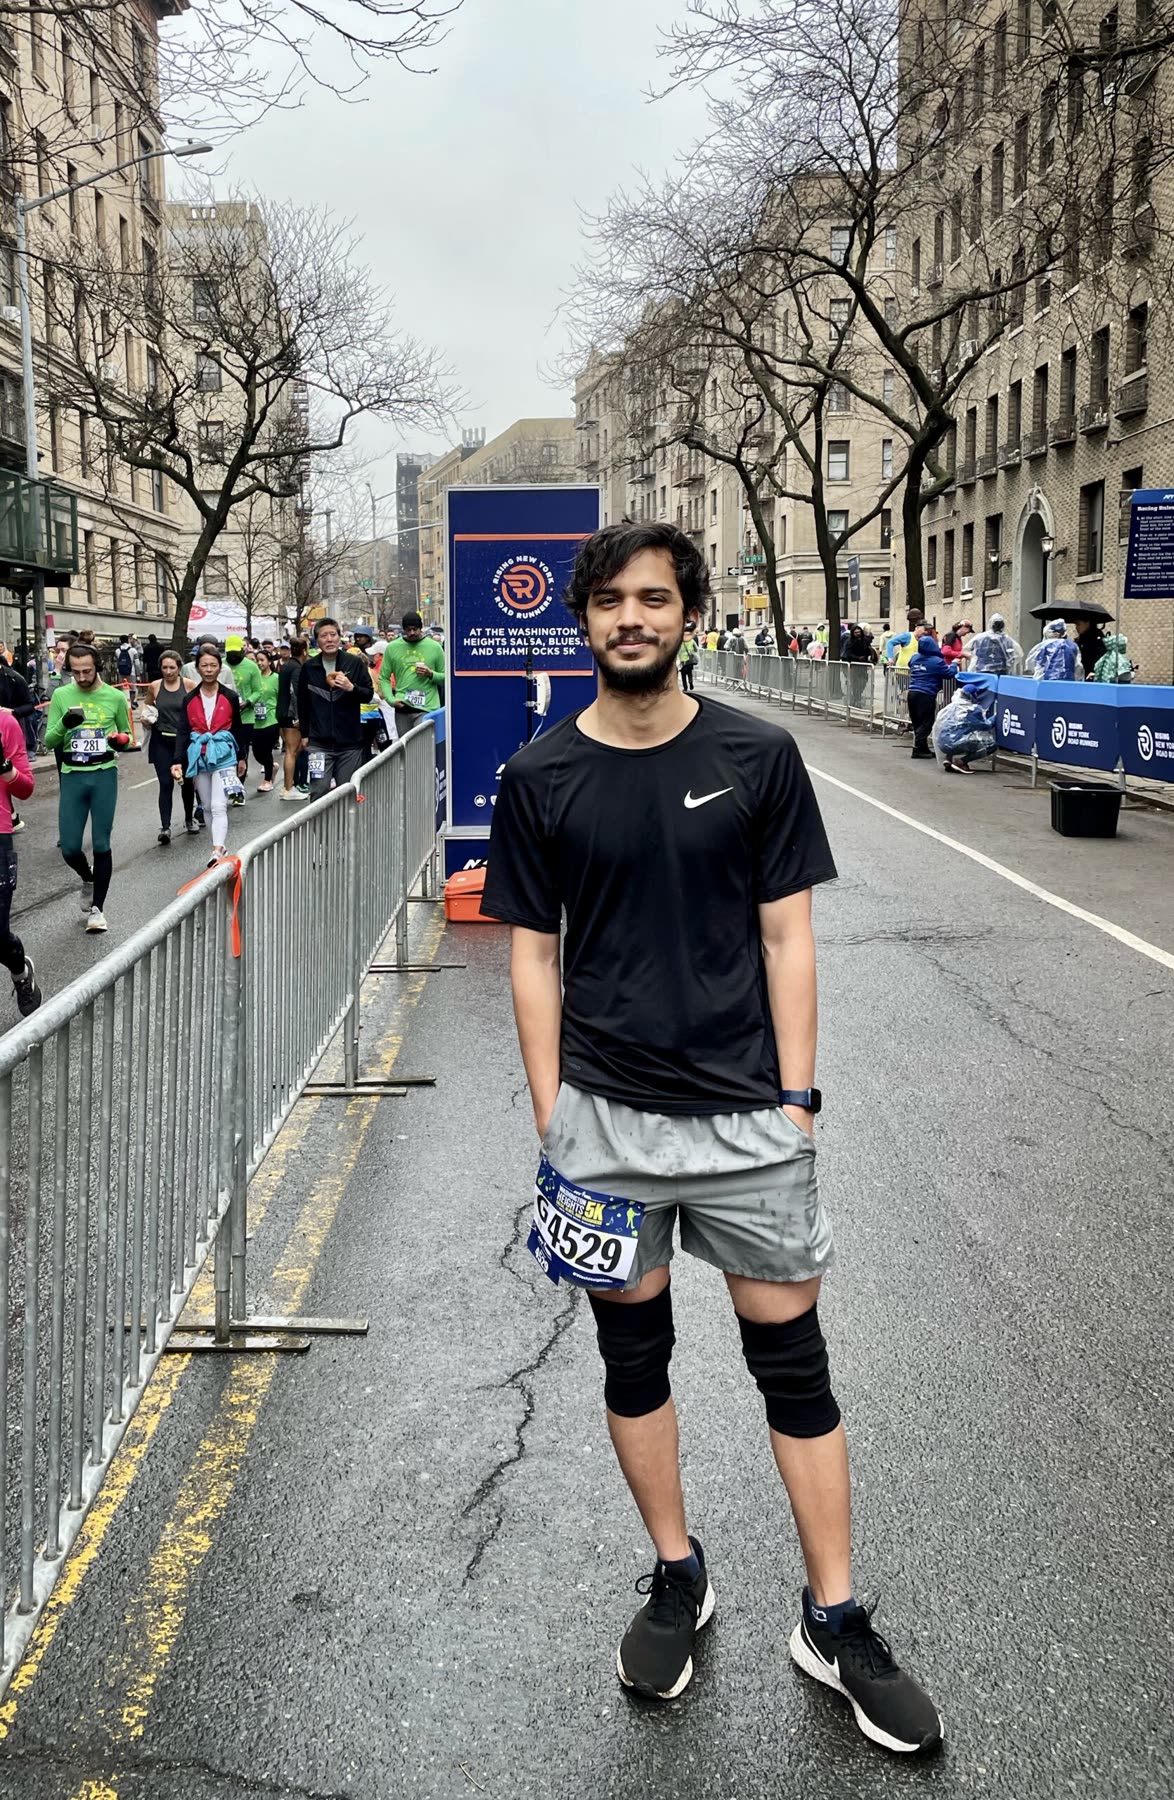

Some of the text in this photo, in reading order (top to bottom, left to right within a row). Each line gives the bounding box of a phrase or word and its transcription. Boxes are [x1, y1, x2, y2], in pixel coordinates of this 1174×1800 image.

[493, 558, 514, 584] RISING
[539, 561, 555, 584] YORK
[494, 595, 553, 619] ROAD RUNNERS
[469, 627, 578, 636] AT THE WASHINGTON
[463, 638, 584, 647] HEIGHTS SALSA, BLUES,
[471, 648, 493, 656] AND
[563, 647, 576, 656] 5K
[83, 740, 100, 752] 281
[584, 1201, 607, 1221] 5K
